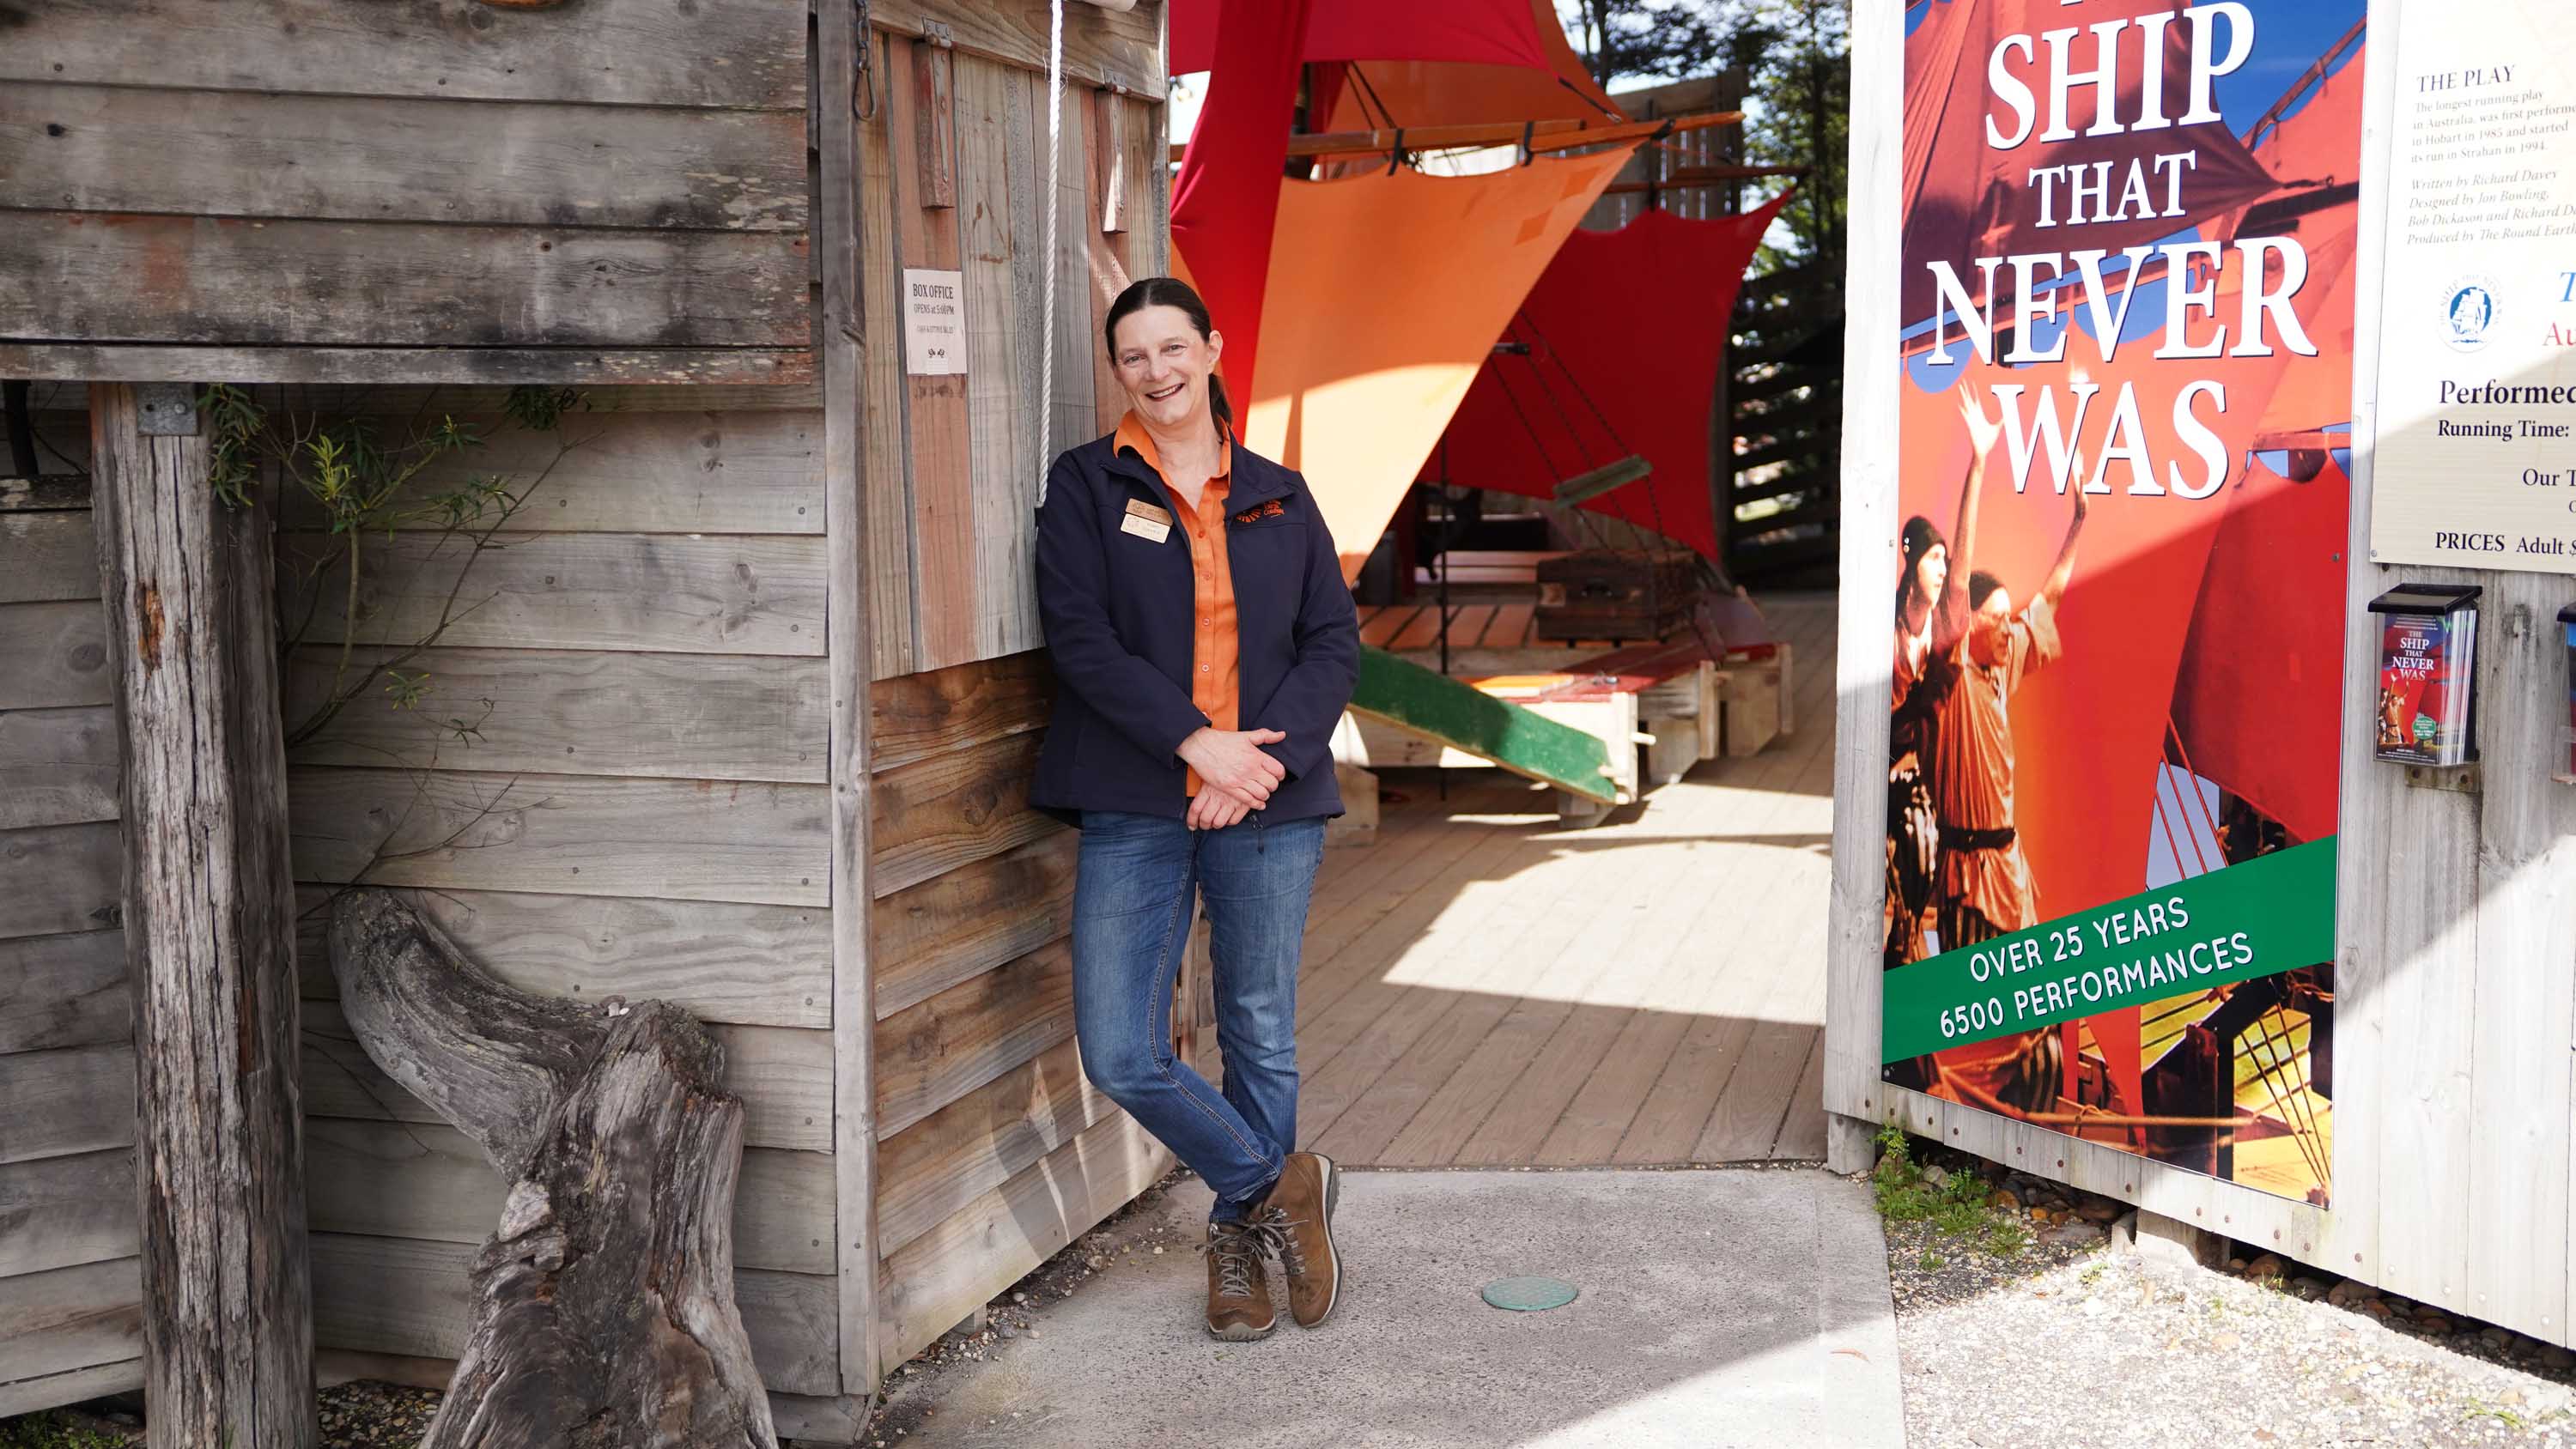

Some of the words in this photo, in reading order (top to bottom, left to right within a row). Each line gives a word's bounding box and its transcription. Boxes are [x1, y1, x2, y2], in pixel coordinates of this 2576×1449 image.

[1985, 1, 2255, 151] SHIP
[2416, 71, 2458, 93] THE
[2464, 64, 2517, 88] PLAY
[2415, 102, 2433, 113] The
[2436, 97, 2472, 111] longest
[2475, 93, 2518, 107] running
[2521, 89, 2543, 104] play
[2413, 120, 2423, 130] in
[2479, 113, 2499, 123] was
[2501, 108, 2524, 121] first
[2412, 136, 2422, 146] in
[2426, 132, 2462, 145] Hobart
[2464, 131, 2475, 142] in
[2479, 128, 2503, 139] 1985
[2506, 124, 2526, 137] and
[2529, 119, 2568, 135] started
[2410, 153, 2423, 163] its
[2426, 151, 2444, 162] run
[2447, 149, 2458, 160] in
[2460, 146, 2501, 159] Strahan
[2505, 144, 2515, 155] in
[2028, 149, 2196, 227] THAT
[2411, 177, 2453, 191] Written
[2456, 174, 2470, 188] by
[2472, 170, 2518, 186] Richard
[2520, 168, 2558, 183] Davey
[2409, 193, 2460, 211] Designed
[2462, 192, 2474, 207] by
[2408, 214, 2429, 227] Bob
[2432, 211, 2482, 227] Dickason
[2486, 208, 2510, 221] and
[2512, 203, 2561, 220] Richard
[2407, 230, 2458, 246] Produced
[2462, 229, 2475, 243] by
[2480, 227, 2500, 240] The
[2501, 226, 2542, 239] Round
[913, 283, 928, 297] BOX
[929, 285, 953, 299] OFFICE
[1926, 236, 2318, 366] NEVER
[914, 303, 930, 314] OPENS
[1991, 379, 2230, 500] WAS
[2438, 419, 2512, 441] Running
[2518, 420, 2569, 438] Time:
[2522, 468, 2560, 487] Our
[2435, 532, 2505, 552] PRICES
[2516, 536, 2565, 555] Adult
[2400, 637, 2430, 651] SHIP
[2404, 649, 2424, 658] THAT
[2391, 656, 2434, 670] NEVER
[2399, 668, 2426, 681] WAS
[1970, 938, 2044, 983] OVER
[2049, 925, 2085, 963] 25
[2093, 897, 2190, 950] YEARS
[1940, 997, 2005, 1040] 6500
[2014, 931, 2254, 1021] PERFORMANCES
